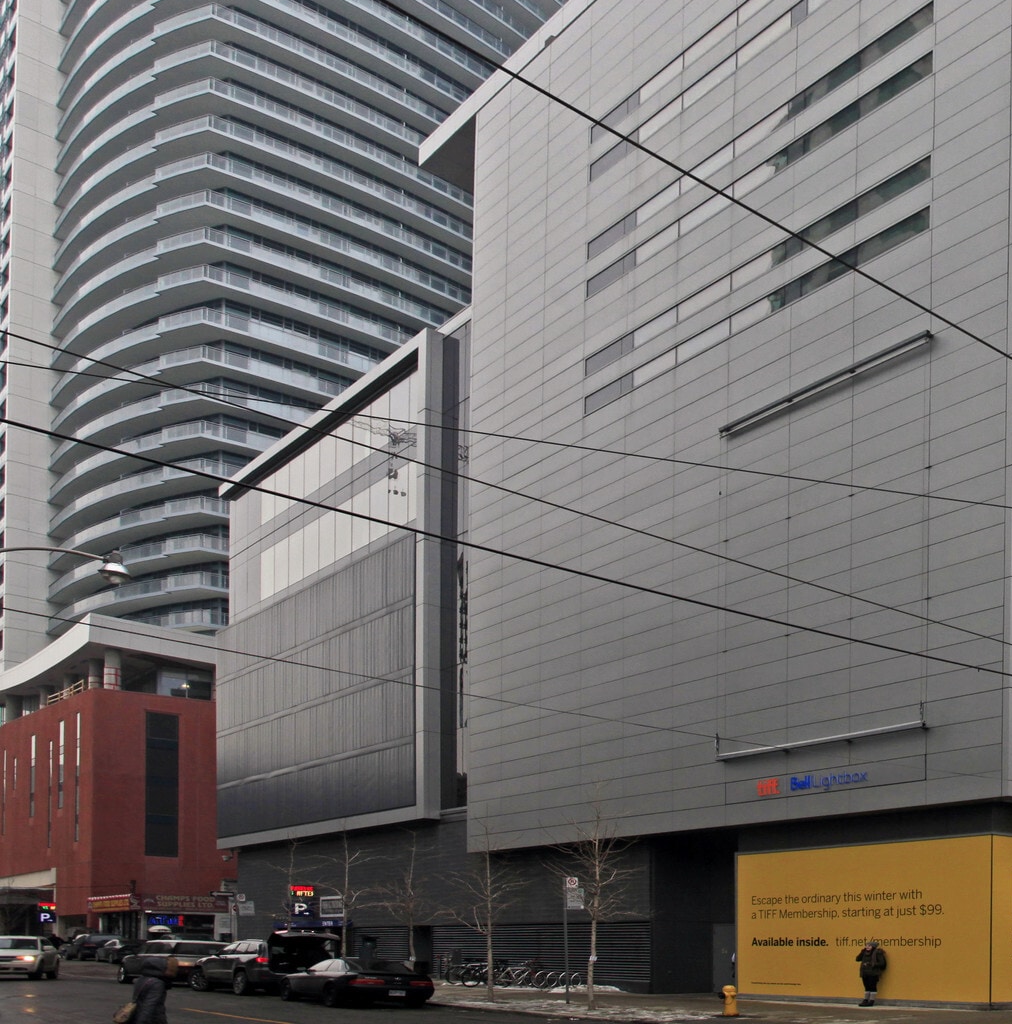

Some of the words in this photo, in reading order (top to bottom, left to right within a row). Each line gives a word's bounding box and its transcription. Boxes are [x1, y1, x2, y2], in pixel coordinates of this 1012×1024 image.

[751, 895, 783, 908] Escape
[785, 894, 800, 904] the
[801, 893, 841, 905] ordinary
[843, 891, 862, 902] this
[864, 890, 897, 901] winter
[899, 889, 923, 900] with
[758, 909, 777, 920] TIFF
[842, 905, 882, 919] starting
[883, 906, 895, 917] at
[895, 904, 917, 918] just
[751, 936, 794, 947] Available
[796, 936, 829, 947] inside.
